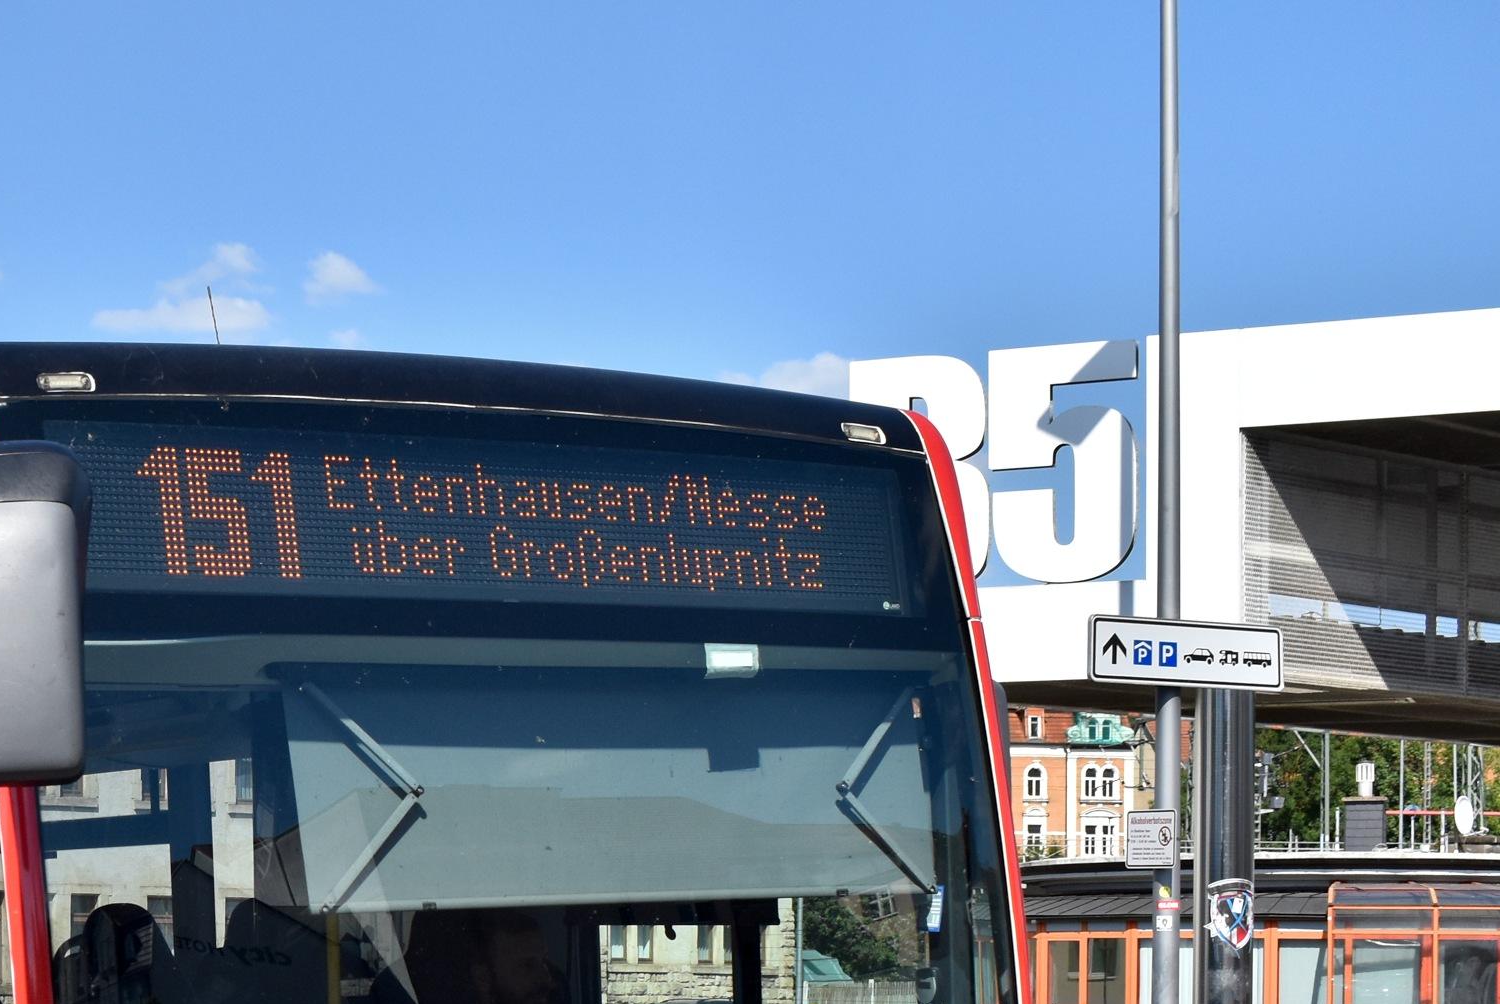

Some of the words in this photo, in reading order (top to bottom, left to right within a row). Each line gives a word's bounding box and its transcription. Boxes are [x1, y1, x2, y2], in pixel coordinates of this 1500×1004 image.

[136, 446, 301, 578] 151
[324, 455, 826, 531] Ettenhausen/Nesse
[351, 520, 464, 575] über
[490, 525, 823, 591] Großenlupnitz
[1162, 645, 1174, 664] P
